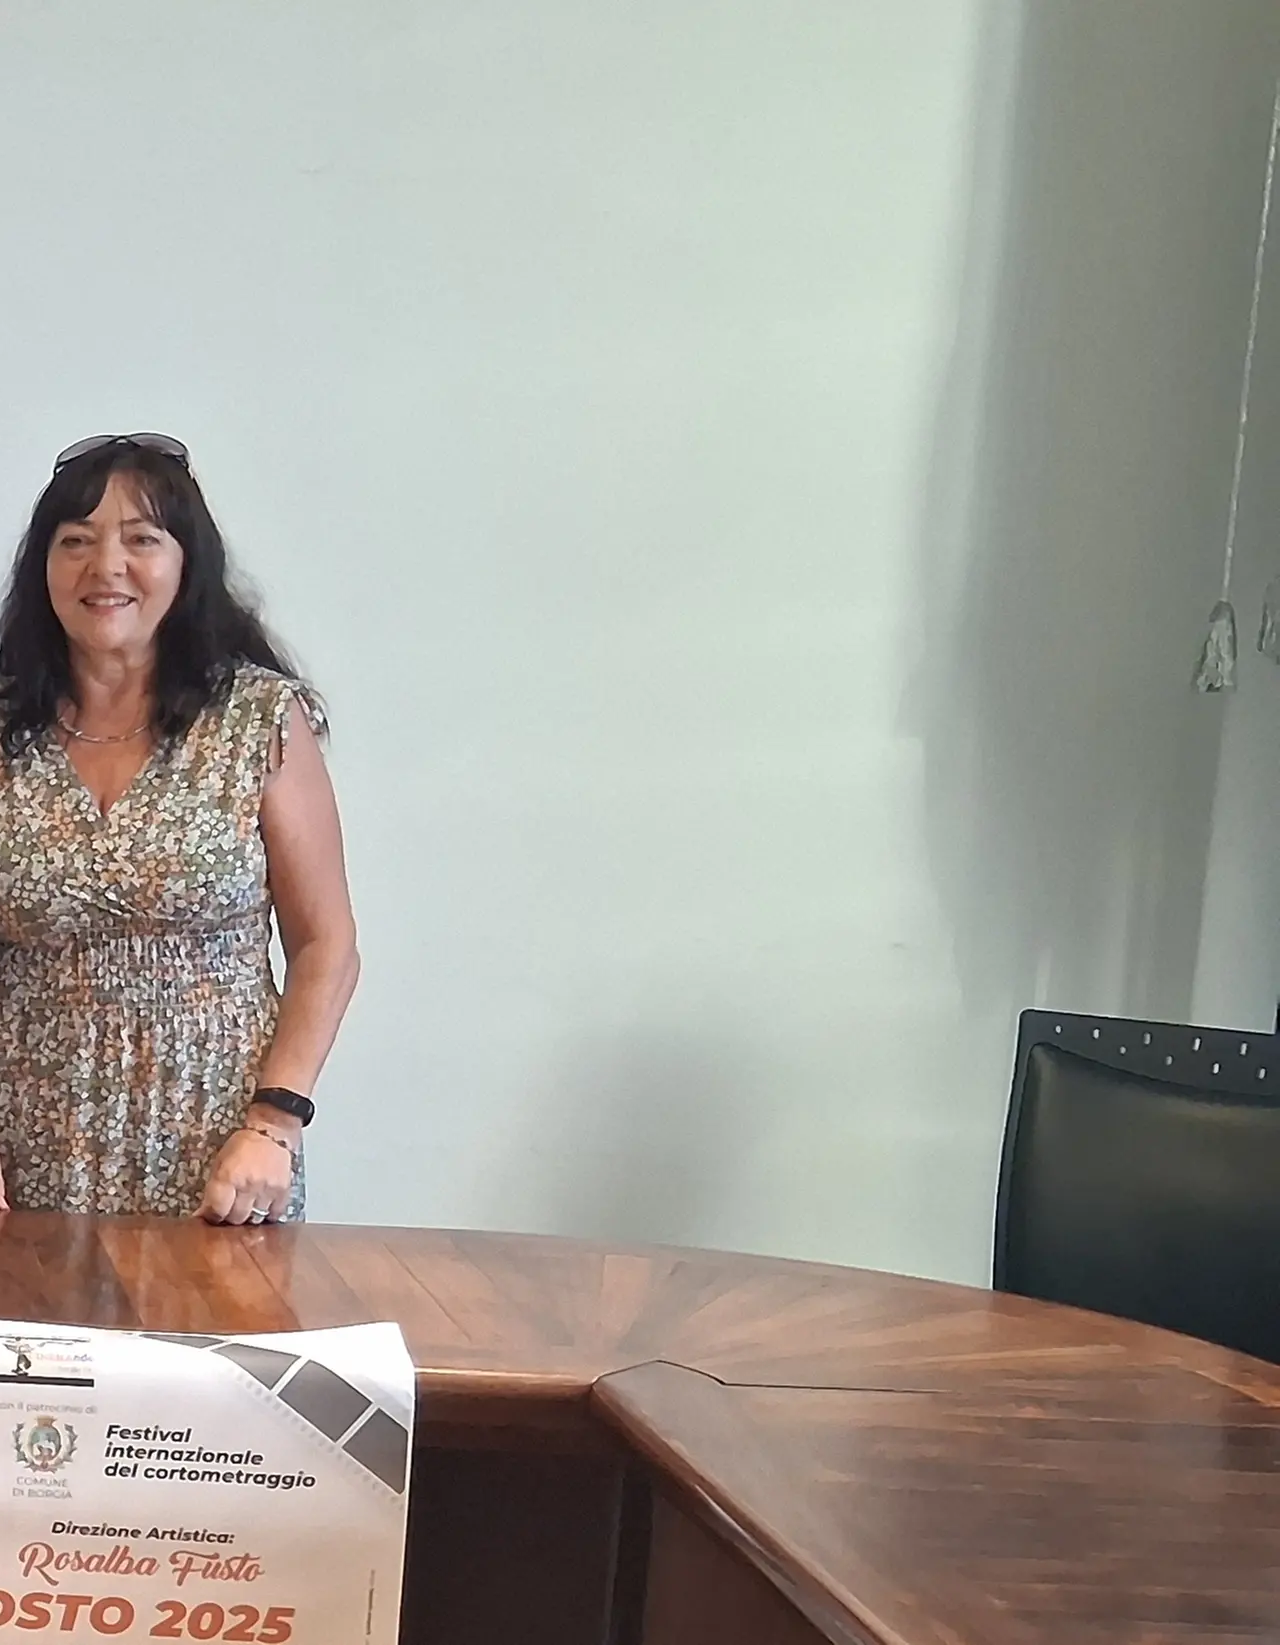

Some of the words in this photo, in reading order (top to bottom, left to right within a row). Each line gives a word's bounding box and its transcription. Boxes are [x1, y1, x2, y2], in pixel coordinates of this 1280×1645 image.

[105, 1424, 192, 1444] Festival
[104, 1442, 264, 1467] internazionale
[16, 1476, 69, 1488] COMUNE
[104, 1462, 139, 1480] del
[143, 1464, 317, 1491] cortometraggio
[27, 1488, 73, 1500] BORGIA
[51, 1521, 142, 1540] Direzione
[145, 1527, 235, 1546] Artistica:
[18, 1541, 160, 1587] Rosalba
[168, 1550, 266, 1588] Fusto
[149, 1599, 297, 1643] 2025
